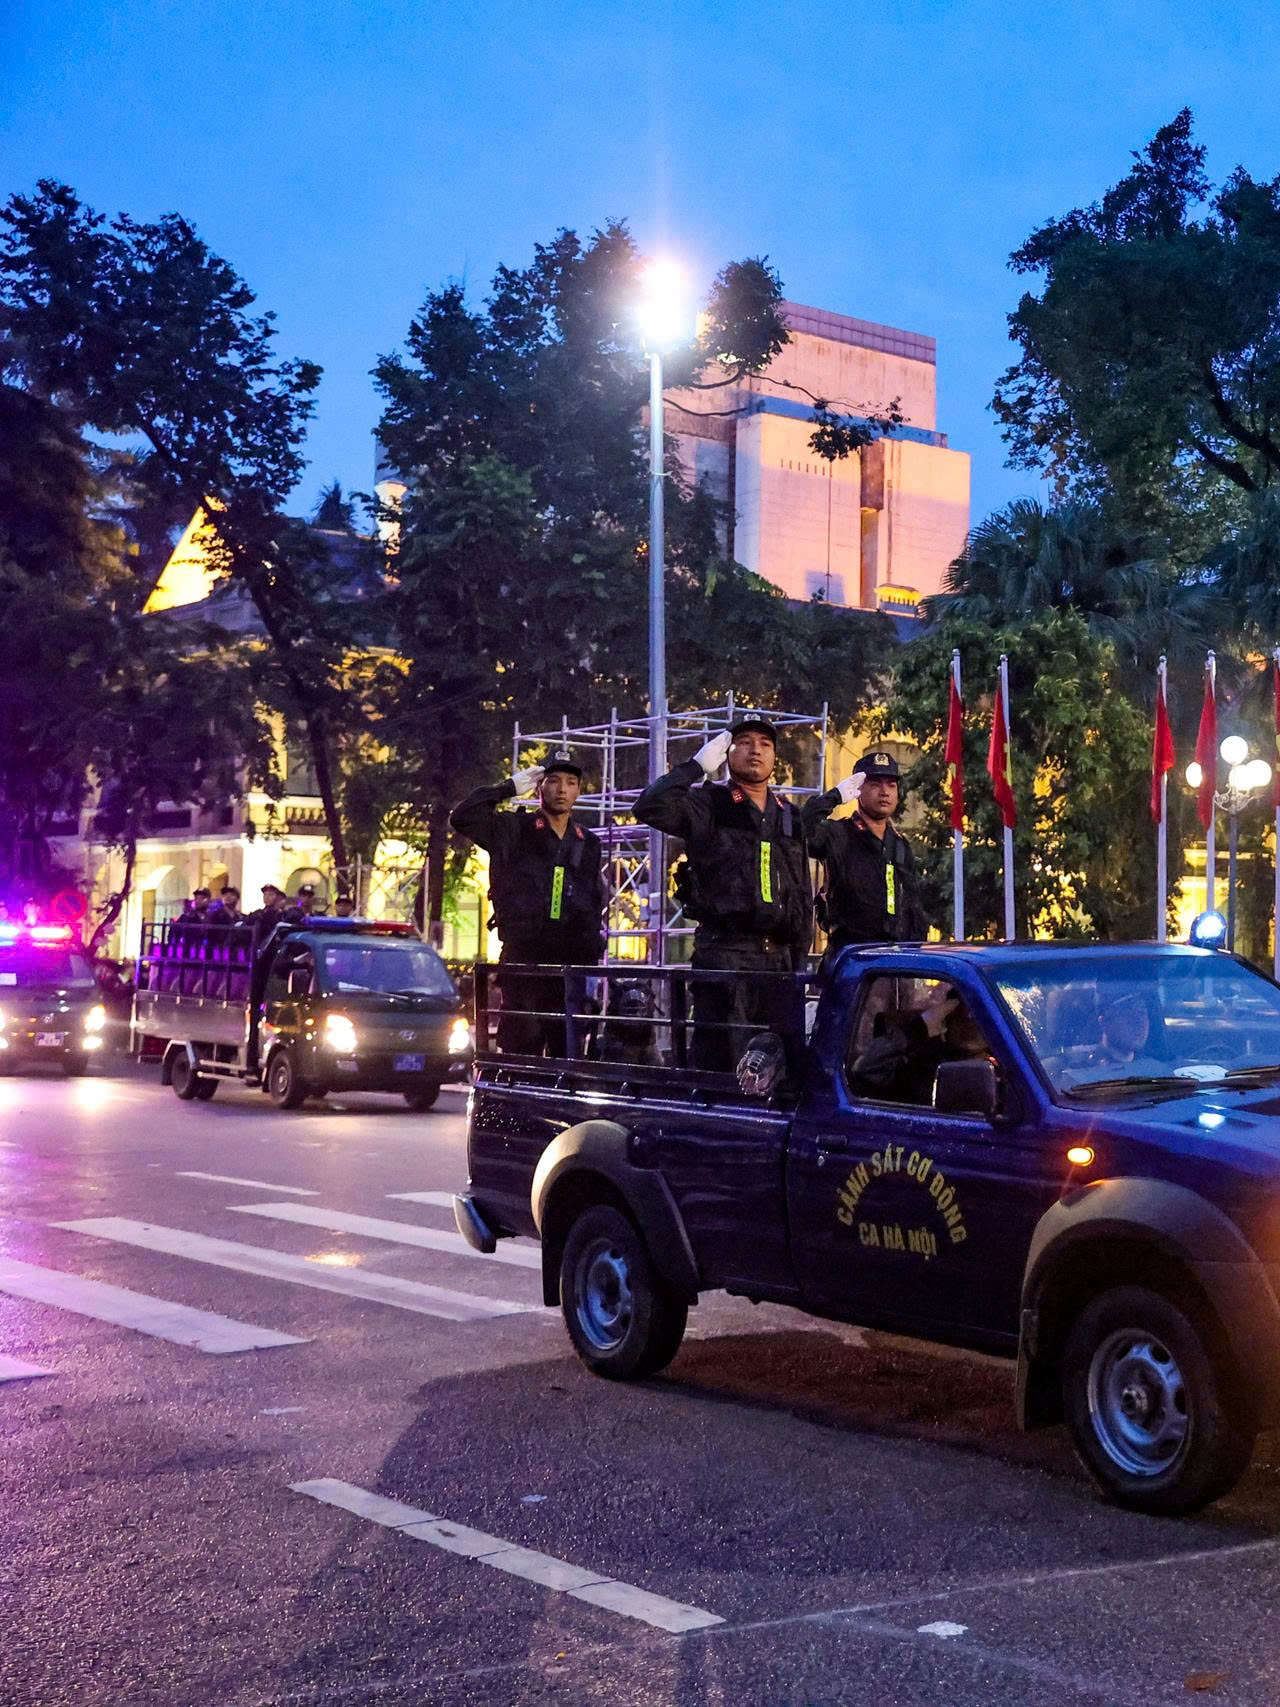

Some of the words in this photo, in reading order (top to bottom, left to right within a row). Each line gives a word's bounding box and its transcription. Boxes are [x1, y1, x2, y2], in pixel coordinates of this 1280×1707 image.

[837, 1162, 869, 1225] CẢNH
[871, 1143, 904, 1175] SÁT
[907, 1151, 933, 1182] CƠ
[859, 1222, 879, 1245] CA
[883, 1223, 905, 1249] HÀ
[908, 1226, 937, 1259] NỘI
